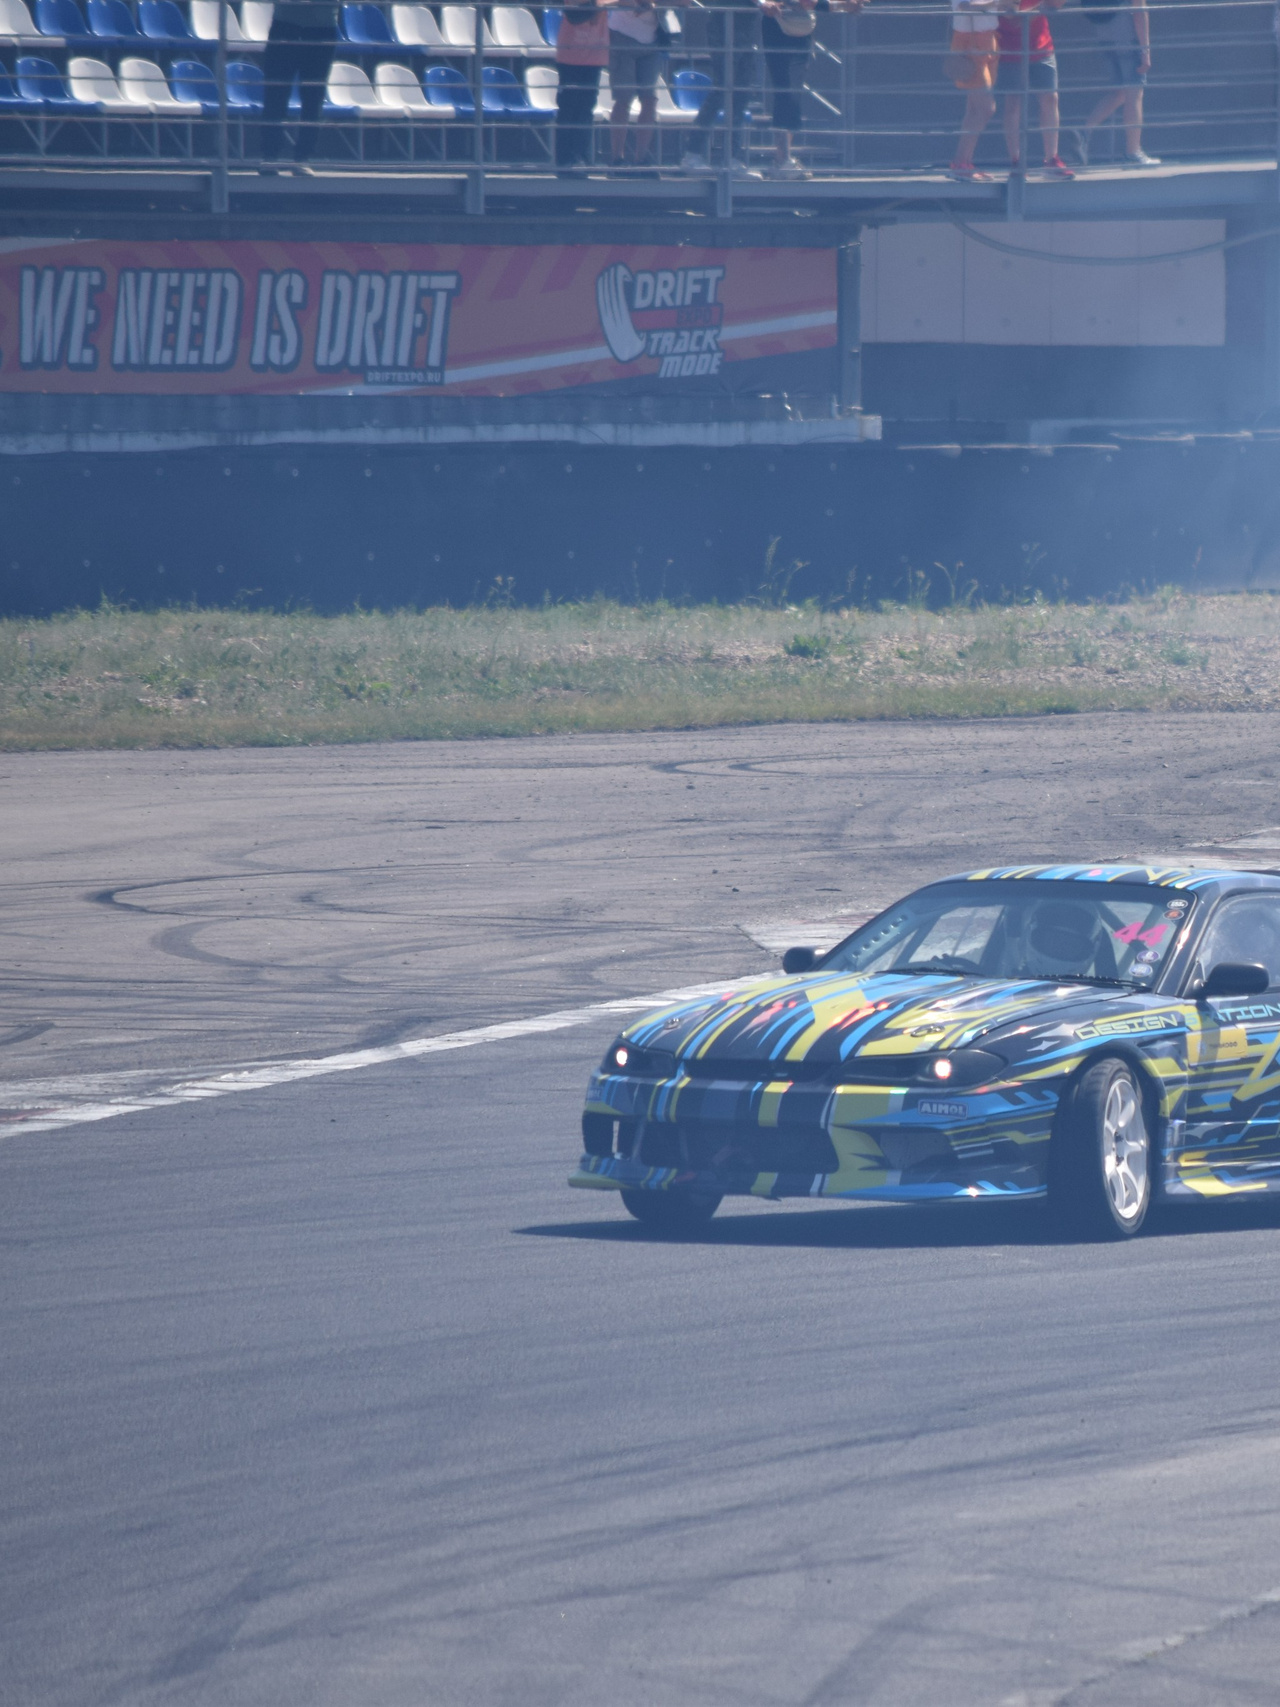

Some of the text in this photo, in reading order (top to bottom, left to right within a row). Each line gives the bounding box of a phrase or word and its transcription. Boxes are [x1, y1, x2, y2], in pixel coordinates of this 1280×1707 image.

[633, 268, 724, 309] DRIFT
[20, 269, 458, 368] WE NEED IS DRIFT
[648, 329, 720, 356] TRACK
[366, 370, 441, 383] DRIFTEXPO.RU
[658, 352, 723, 378] MODE
[1112, 921, 1169, 948] 44
[1074, 1013, 1179, 1040] DESIGN
[920, 1102, 964, 1116] AIMOL
